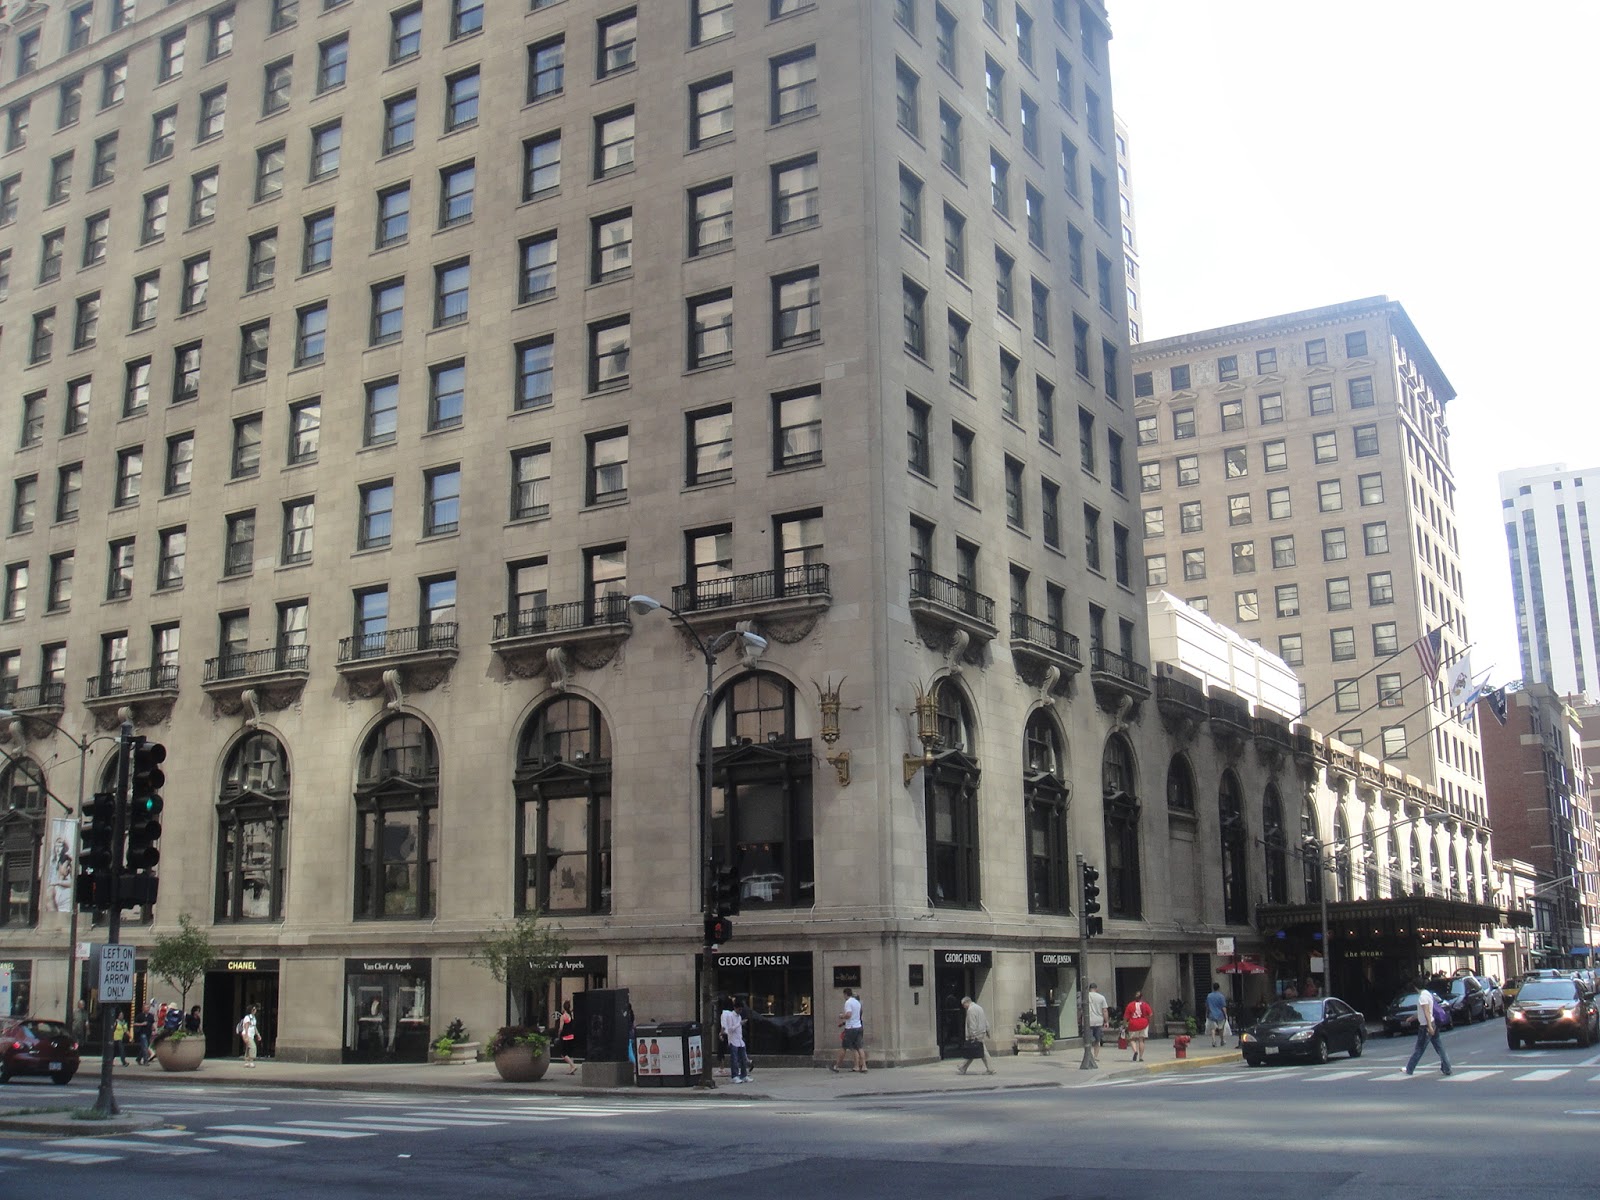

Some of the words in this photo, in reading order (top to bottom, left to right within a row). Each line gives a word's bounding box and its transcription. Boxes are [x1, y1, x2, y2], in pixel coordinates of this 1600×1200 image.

[103, 947, 120, 959] LEFT
[122, 948, 133, 959] ON
[945, 953, 962, 963] GEORG
[963, 953, 981, 964] JENSEN
[718, 956, 751, 966] GEORG
[754, 955, 789, 967] JENSEN
[1042, 954, 1057, 964] GEORG
[1057, 954, 1071, 964] JENSEN
[105, 961, 129, 972] GREEN
[228, 961, 256, 970] CHANEL
[363, 962, 374, 970] Van
[374, 962, 389, 970] Cleef
[395, 962, 411, 971] Arpels
[565, 961, 584, 970] Arpels
[104, 974, 130, 985] ARROW
[107, 986, 126, 997] ONLY
